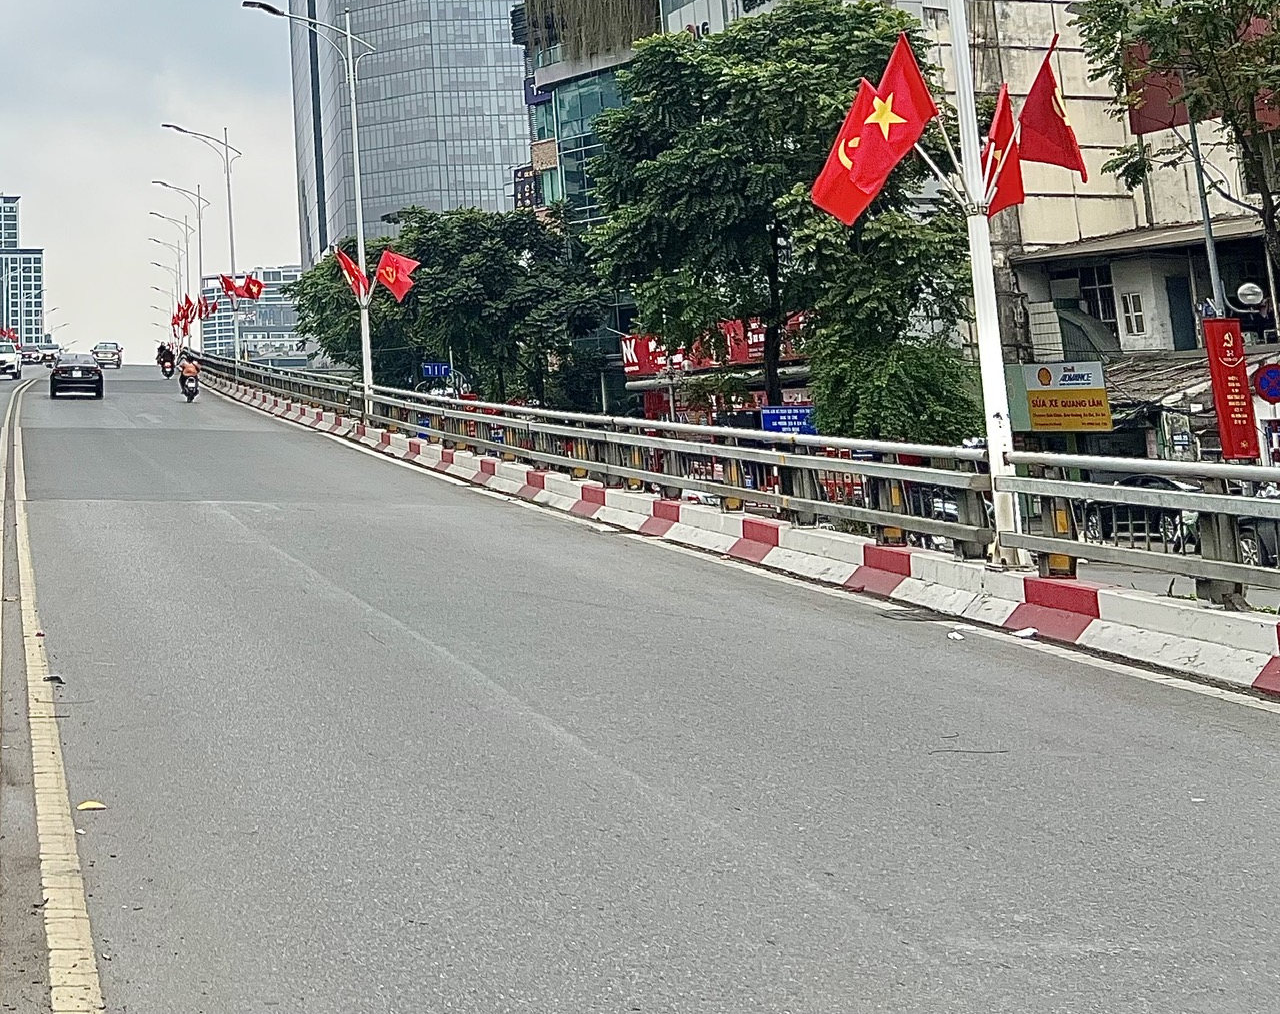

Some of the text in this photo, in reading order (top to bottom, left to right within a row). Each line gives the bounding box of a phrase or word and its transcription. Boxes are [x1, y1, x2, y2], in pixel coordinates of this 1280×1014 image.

[622, 338, 638, 364] NK
[1059, 373, 1092, 382] ADVANCE
[1049, 399, 1059, 408] XE
[1061, 399, 1087, 408] QUANG
